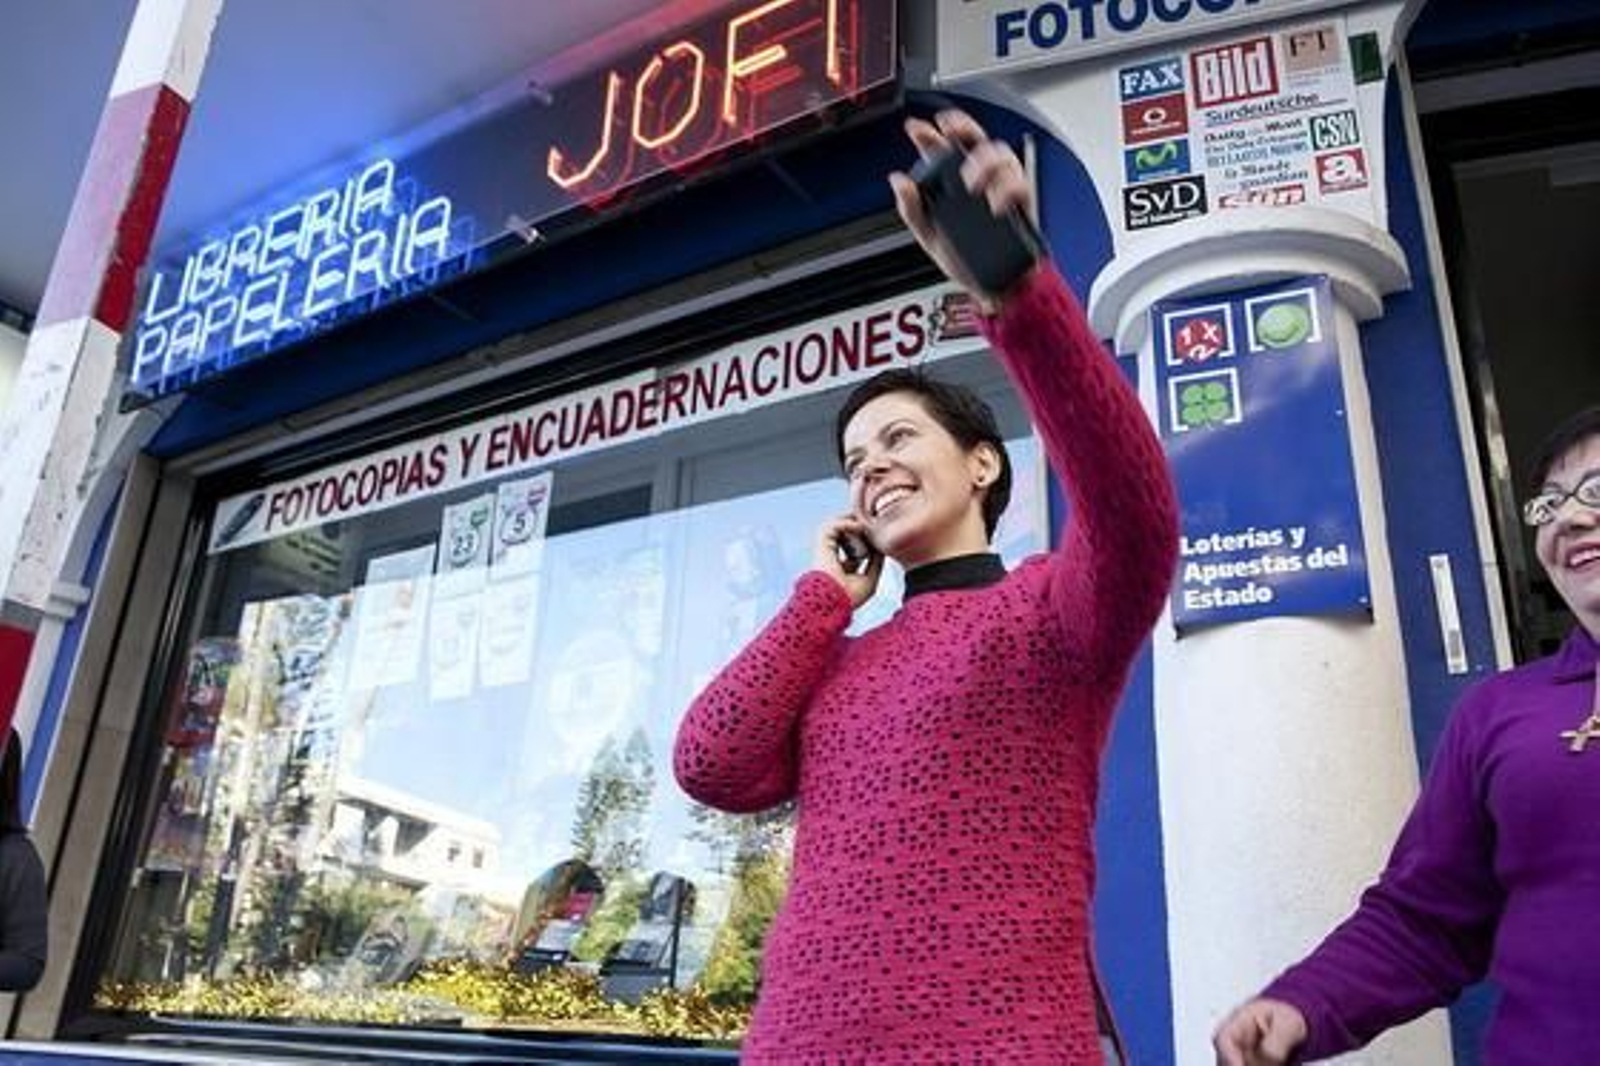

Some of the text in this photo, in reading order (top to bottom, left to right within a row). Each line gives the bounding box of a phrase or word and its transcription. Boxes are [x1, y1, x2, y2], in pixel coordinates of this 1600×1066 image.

[996, 0, 1258, 57] FOTOC
[1122, 62, 1181, 95] FAX
[1195, 41, 1271, 103] Bild
[1129, 181, 1200, 216] SvD
[144, 158, 395, 324] LIBRERIA
[131, 196, 451, 385] PAPELERIA
[264, 304, 926, 532] FOTOCOPIAS Y ENCUADERNACIONES
[512, 511, 526, 533] 5
[1180, 526, 1306, 555] Loterías y
[1184, 545, 1349, 585] Apuestas del
[1184, 583, 1273, 610] Estado
